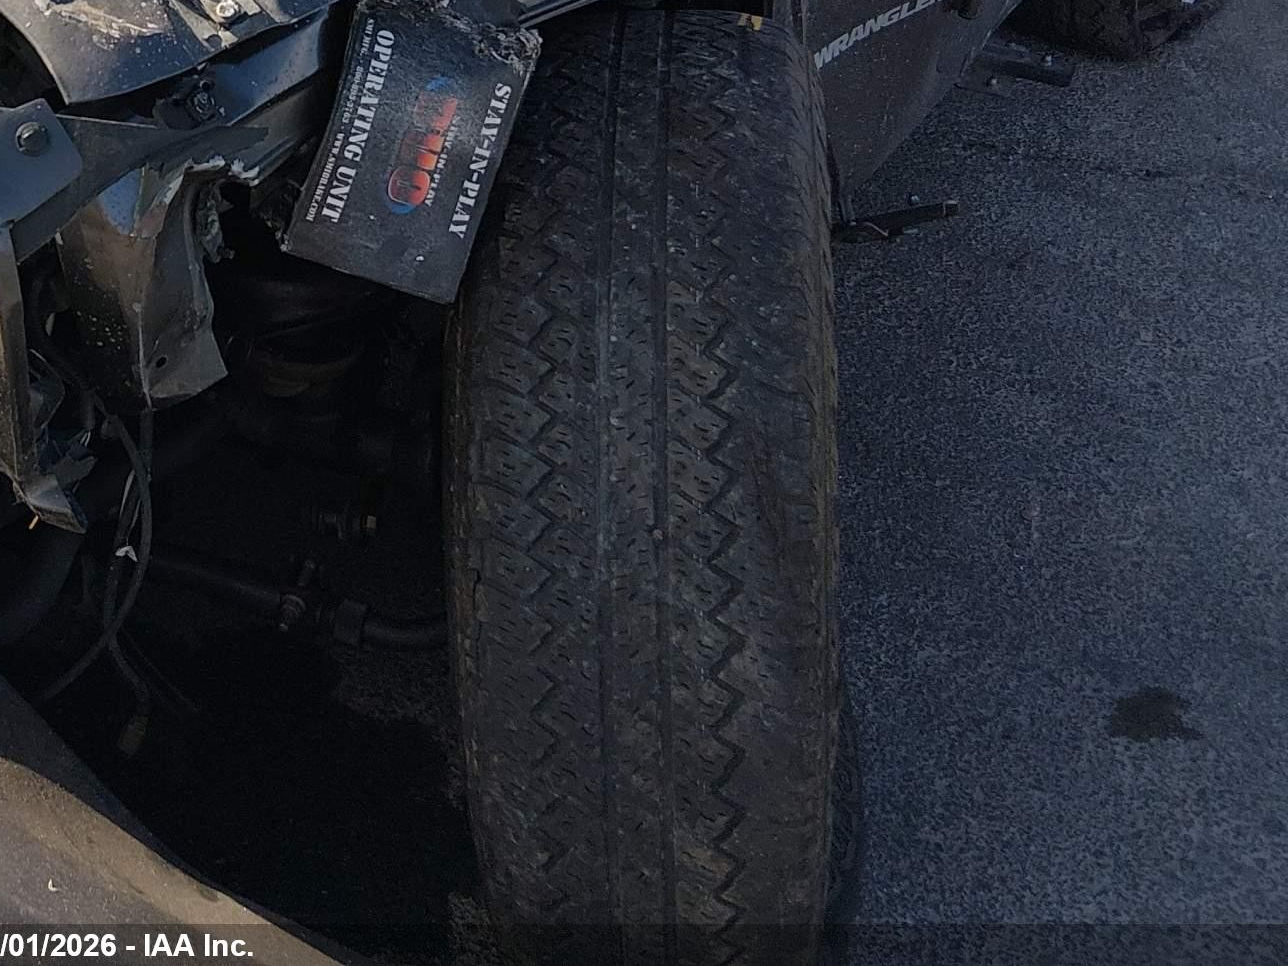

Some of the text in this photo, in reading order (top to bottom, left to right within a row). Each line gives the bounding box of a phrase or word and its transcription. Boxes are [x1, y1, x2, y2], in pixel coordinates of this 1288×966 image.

[321, 29, 396, 223] OPERATING UNIT
[448, 83, 511, 238] STAY-IN-PLAY
